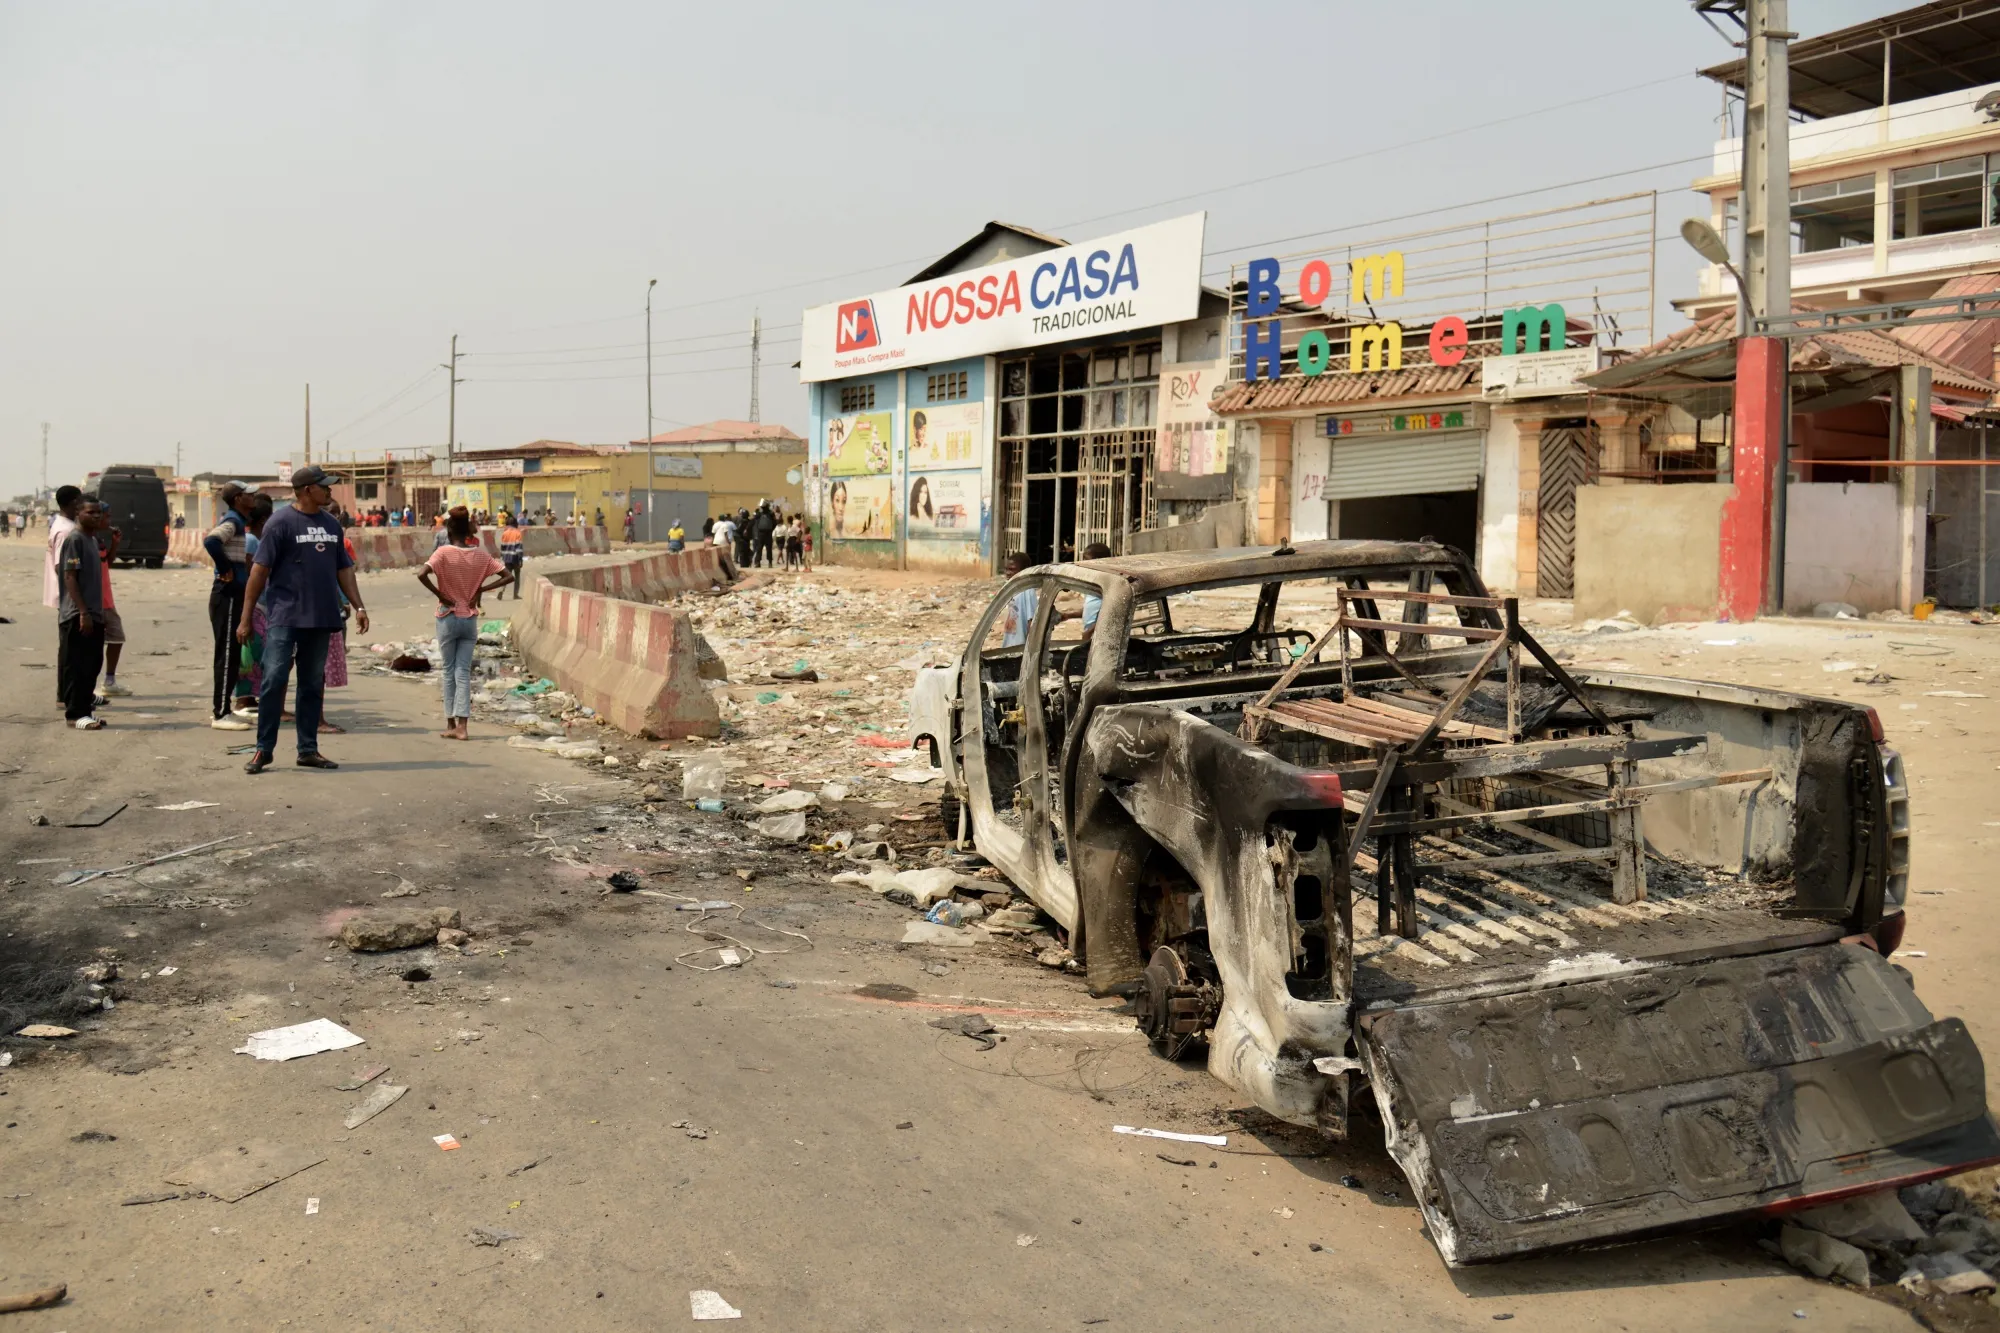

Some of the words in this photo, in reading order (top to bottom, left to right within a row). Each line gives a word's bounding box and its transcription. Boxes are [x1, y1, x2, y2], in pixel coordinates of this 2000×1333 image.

[906, 270, 1022, 335] NOSSA
[1030, 243, 1139, 310] CASA
[1032, 300, 1137, 334] TRADICIONAL
[1248, 251, 1404, 317] Bom
[1245, 303, 1566, 382] Homem
[307, 526, 327, 535] DA
